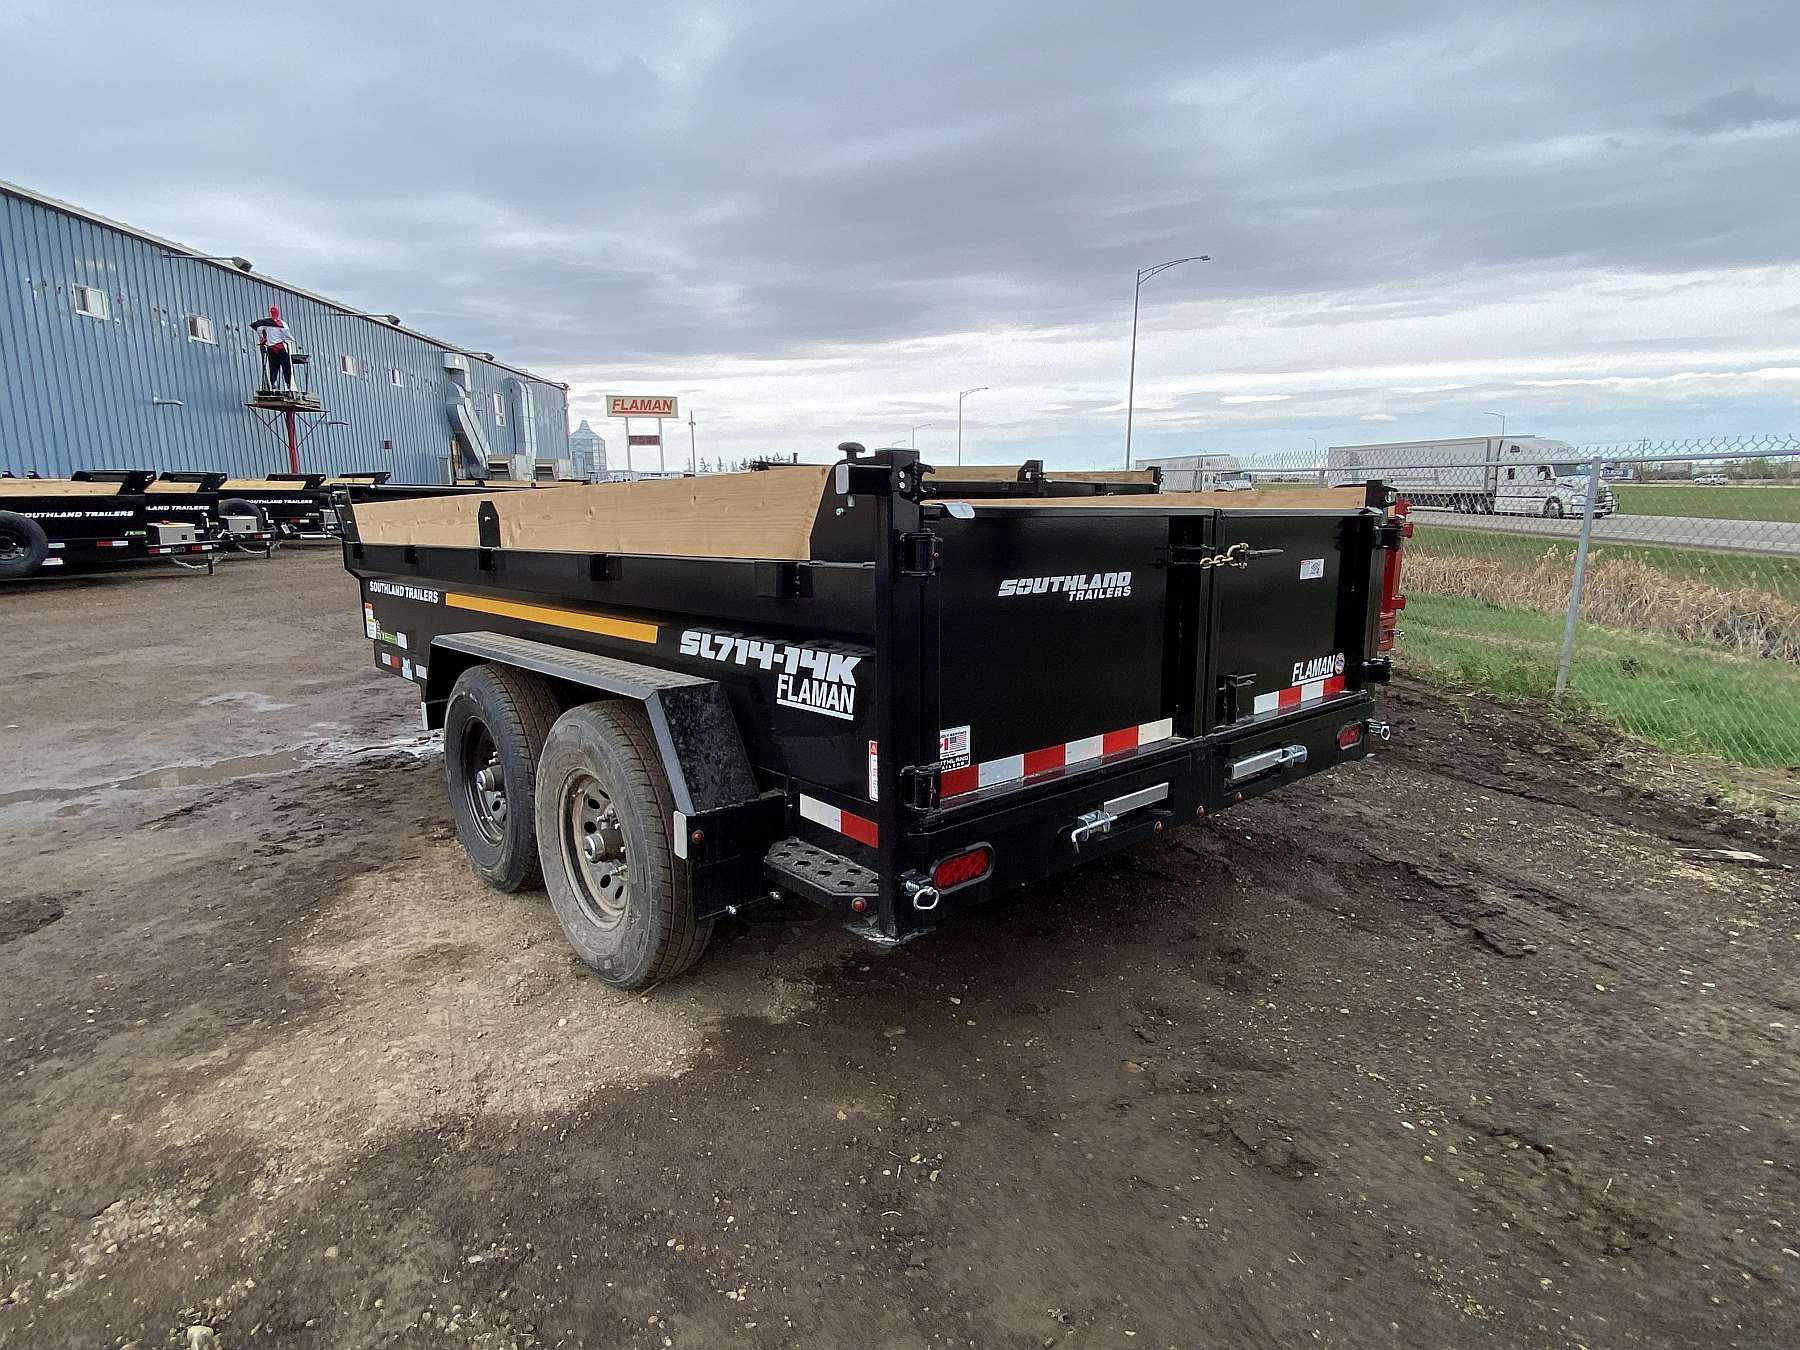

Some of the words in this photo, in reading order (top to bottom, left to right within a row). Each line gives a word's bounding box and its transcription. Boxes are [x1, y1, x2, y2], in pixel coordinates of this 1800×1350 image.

[612, 399, 673, 412] FLAMAN
[85, 510, 134, 518] TRAILERS
[369, 580, 405, 597] SOUTHLAND
[405, 586, 439, 604] TRAILERS
[998, 571, 1132, 597] SOUTHLAND
[1068, 585, 1132, 602] TRAILERS
[679, 630, 862, 687] SL714-14K
[1291, 654, 1336, 682] FLAMAN
[776, 673, 856, 714] FLAMAN
